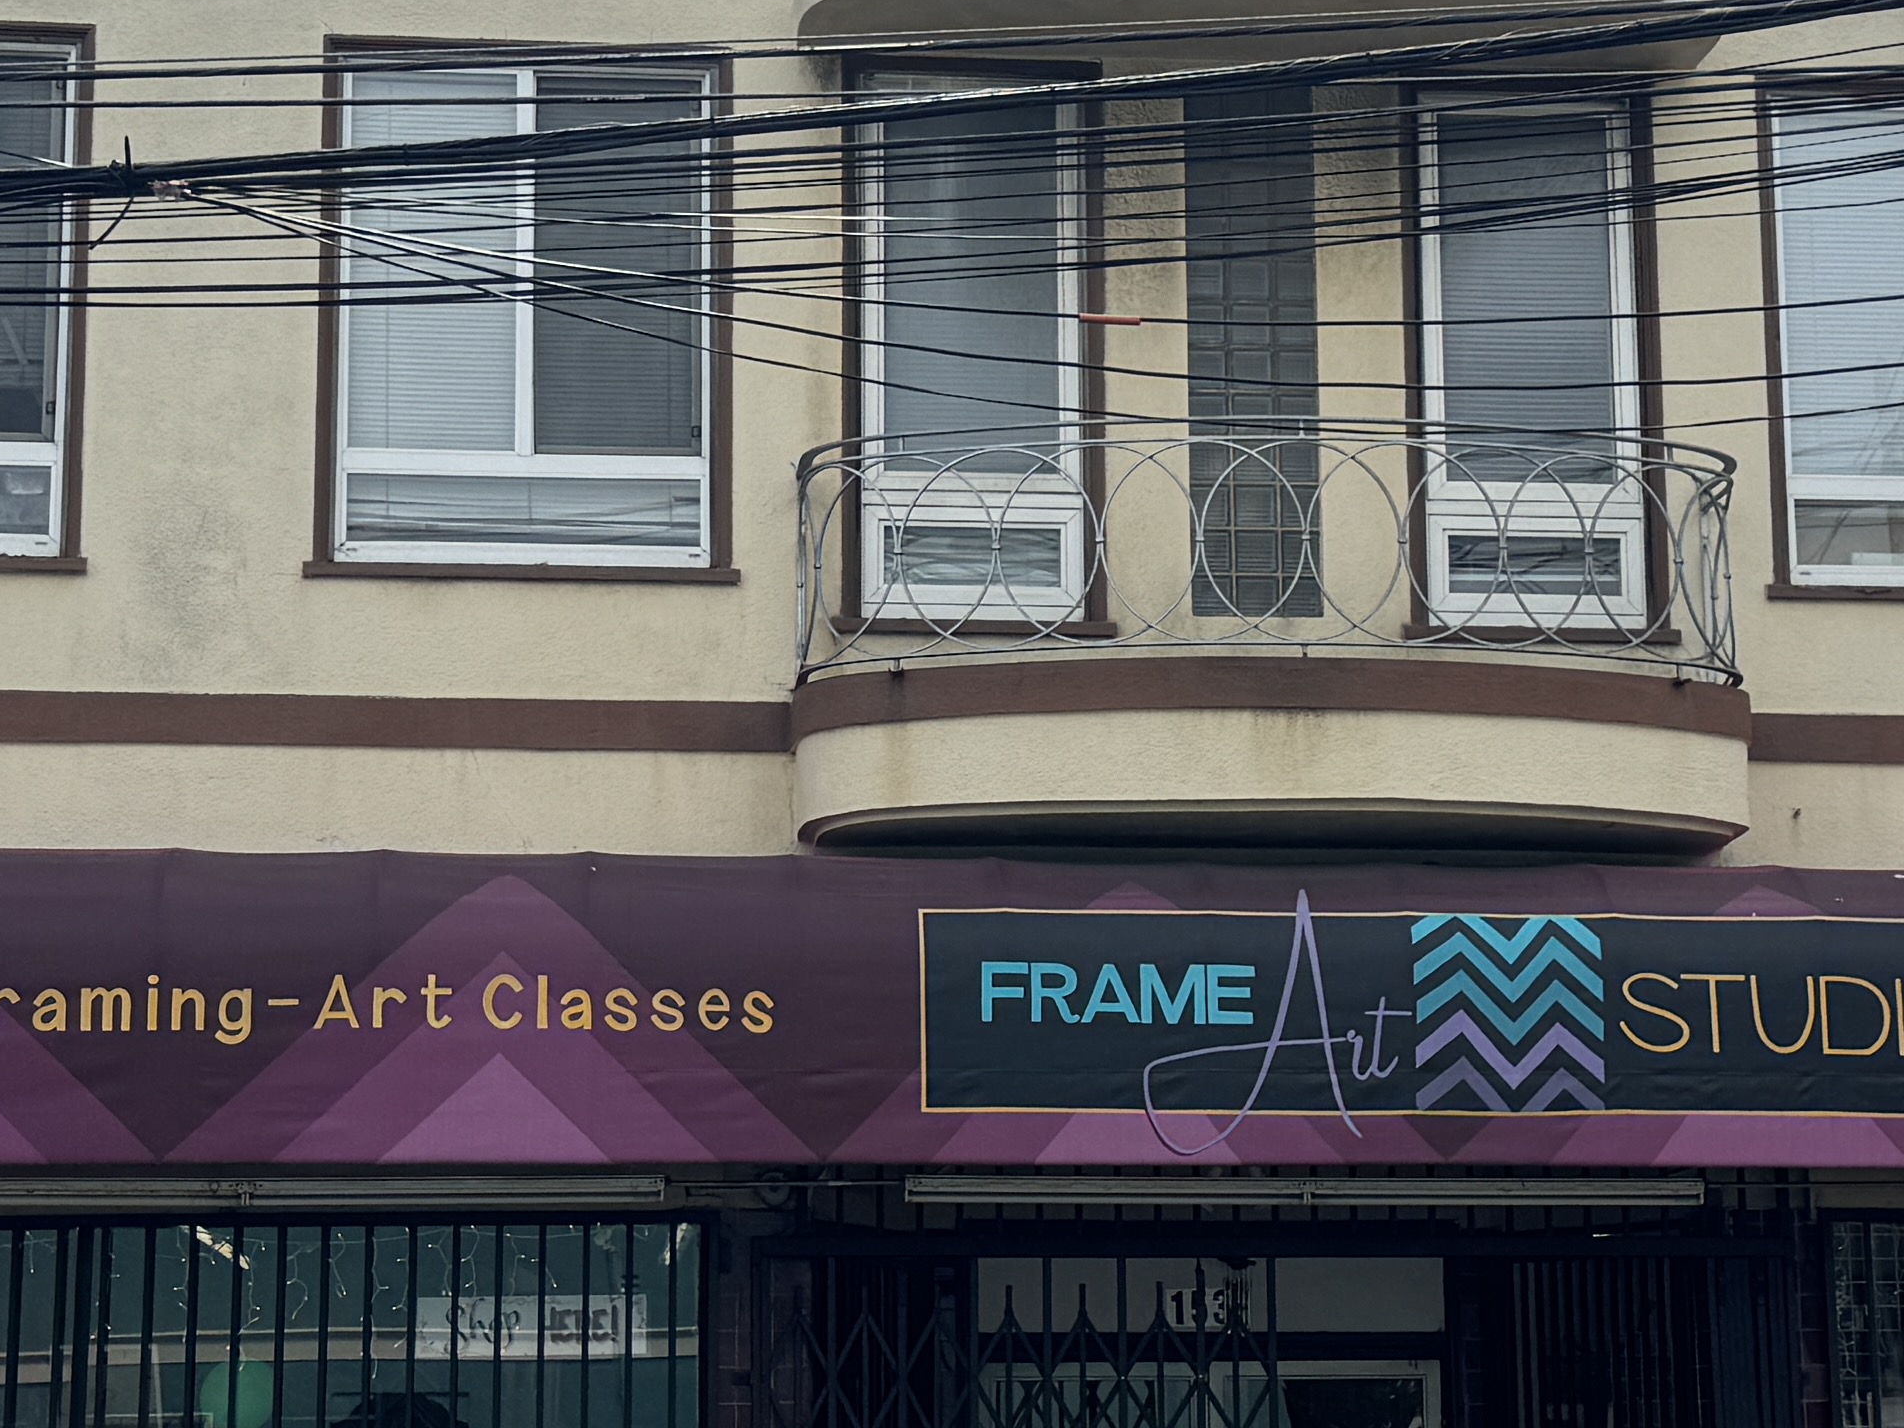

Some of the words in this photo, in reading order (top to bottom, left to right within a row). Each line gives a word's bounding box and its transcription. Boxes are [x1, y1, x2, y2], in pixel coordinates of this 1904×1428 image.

[483, 975, 775, 1035] Classes
[979, 959, 1256, 1026] FRAME
[1143, 887, 1412, 1157] Art
